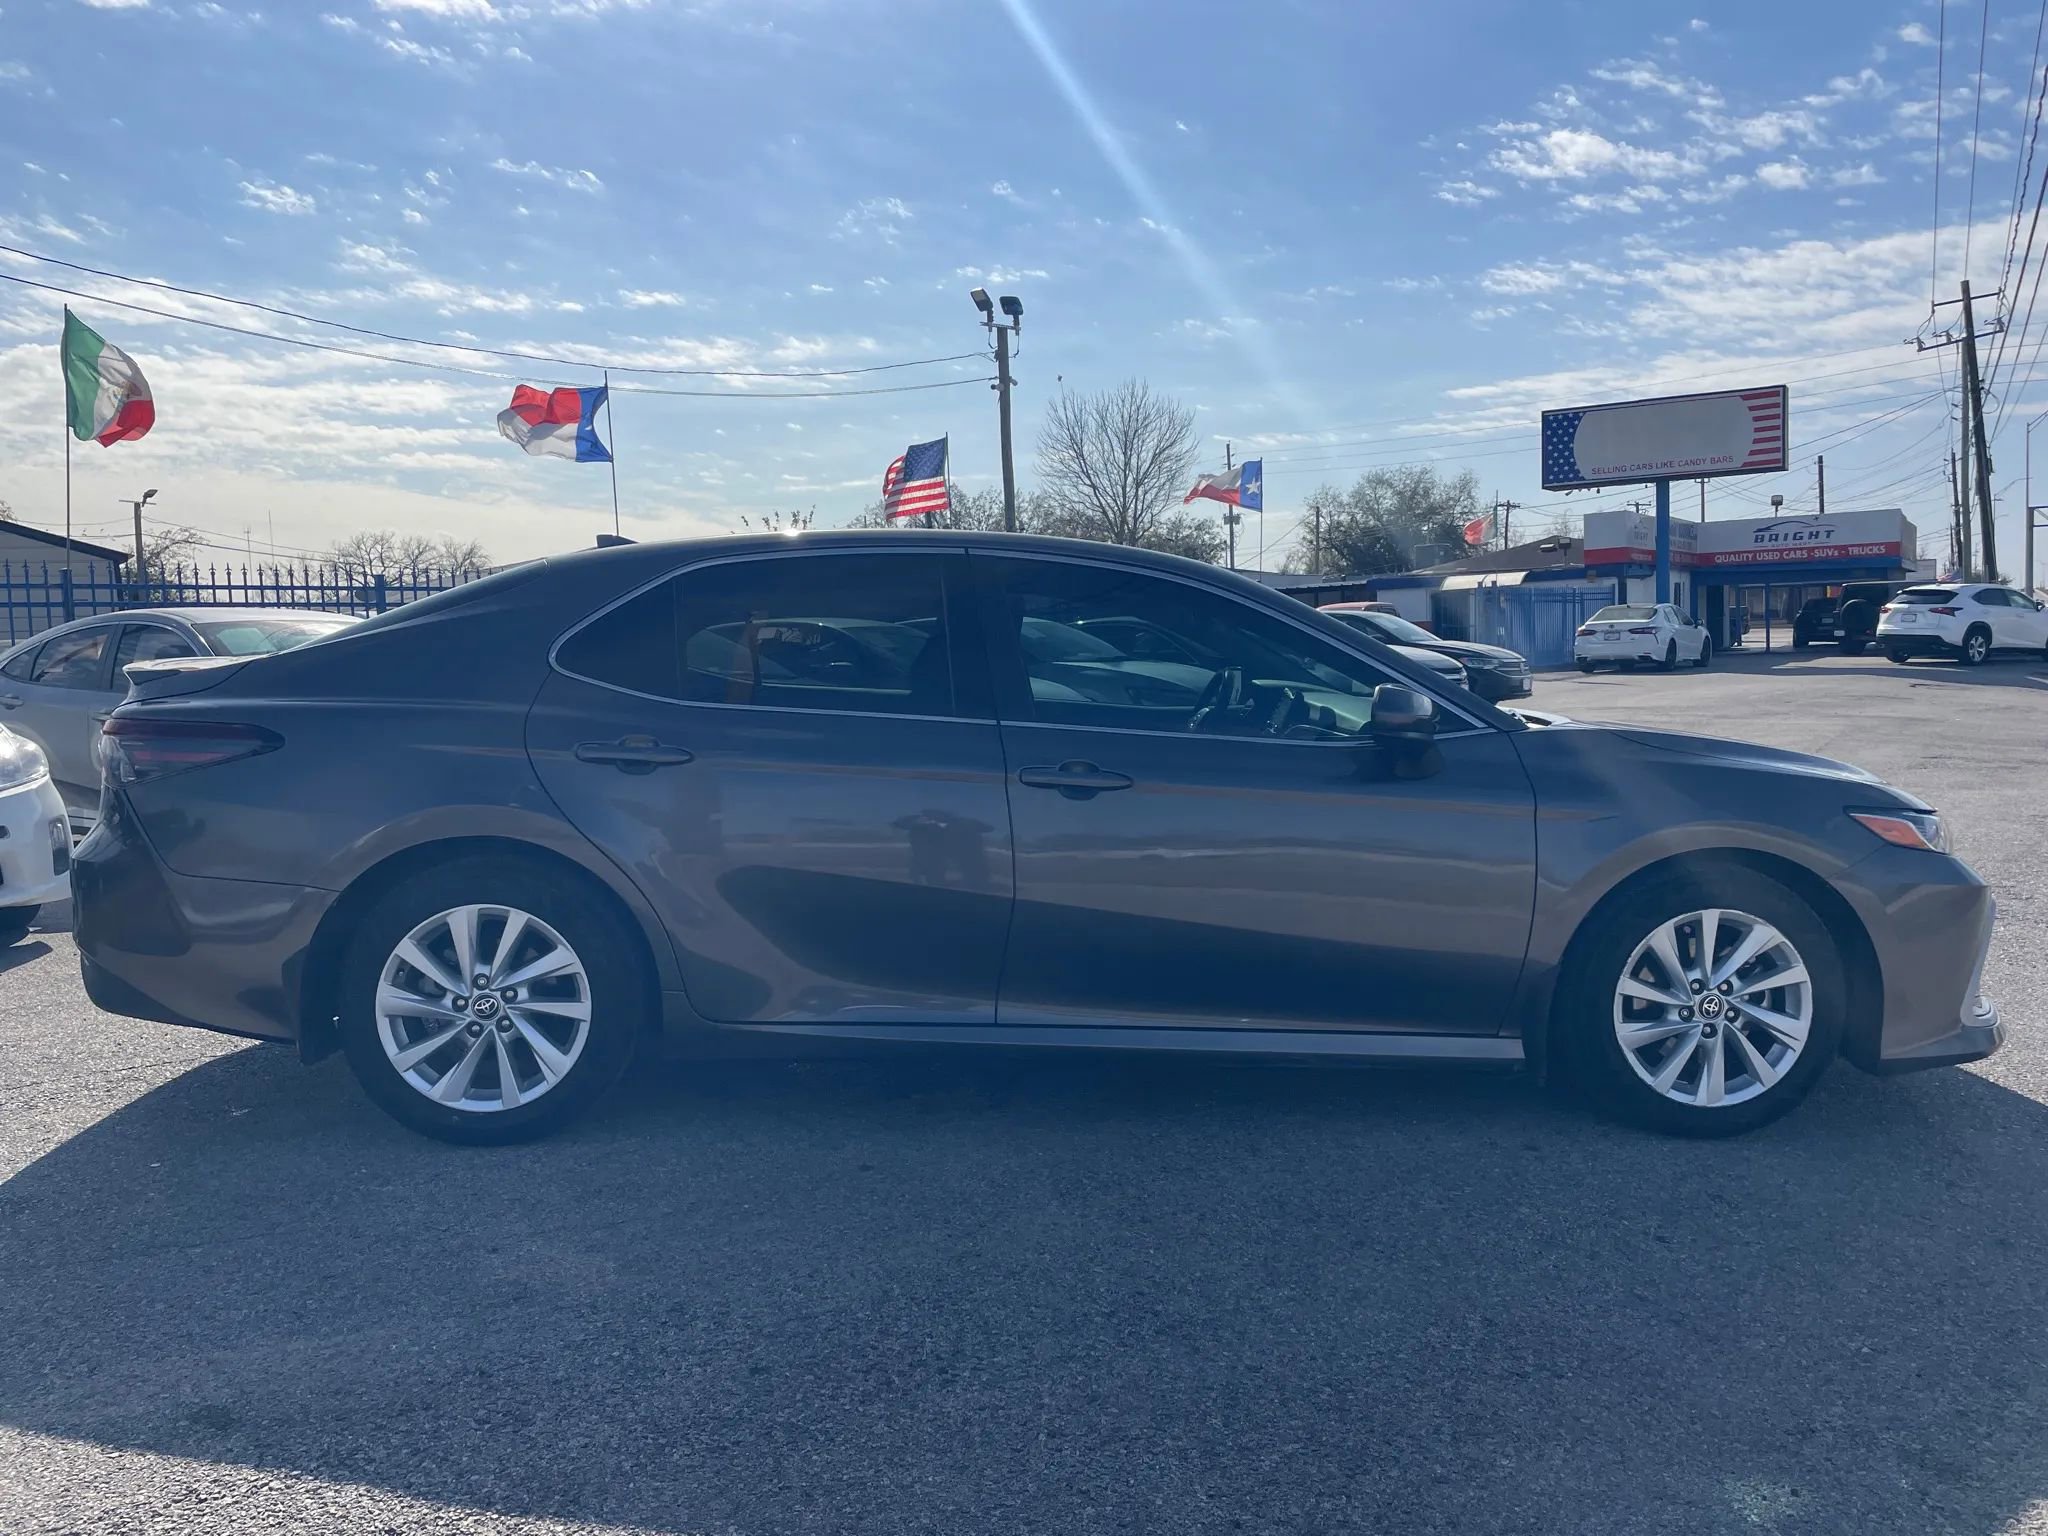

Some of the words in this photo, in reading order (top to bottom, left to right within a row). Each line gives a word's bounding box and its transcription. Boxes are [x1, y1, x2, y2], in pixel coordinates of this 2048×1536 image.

[1592, 465, 1627, 475] SELLING
[1630, 463, 1653, 472] CARS
[1655, 461, 1675, 470] LIKE
[1678, 458, 1707, 467] CANDY
[1710, 455, 1734, 465] BARS
[1753, 529, 1835, 544] BRIGHT
[1714, 552, 1753, 563] QUALITY
[1756, 551, 1779, 561] USED
[1783, 550, 1808, 560] CARS
[1848, 545, 1886, 555] TRUCKS
